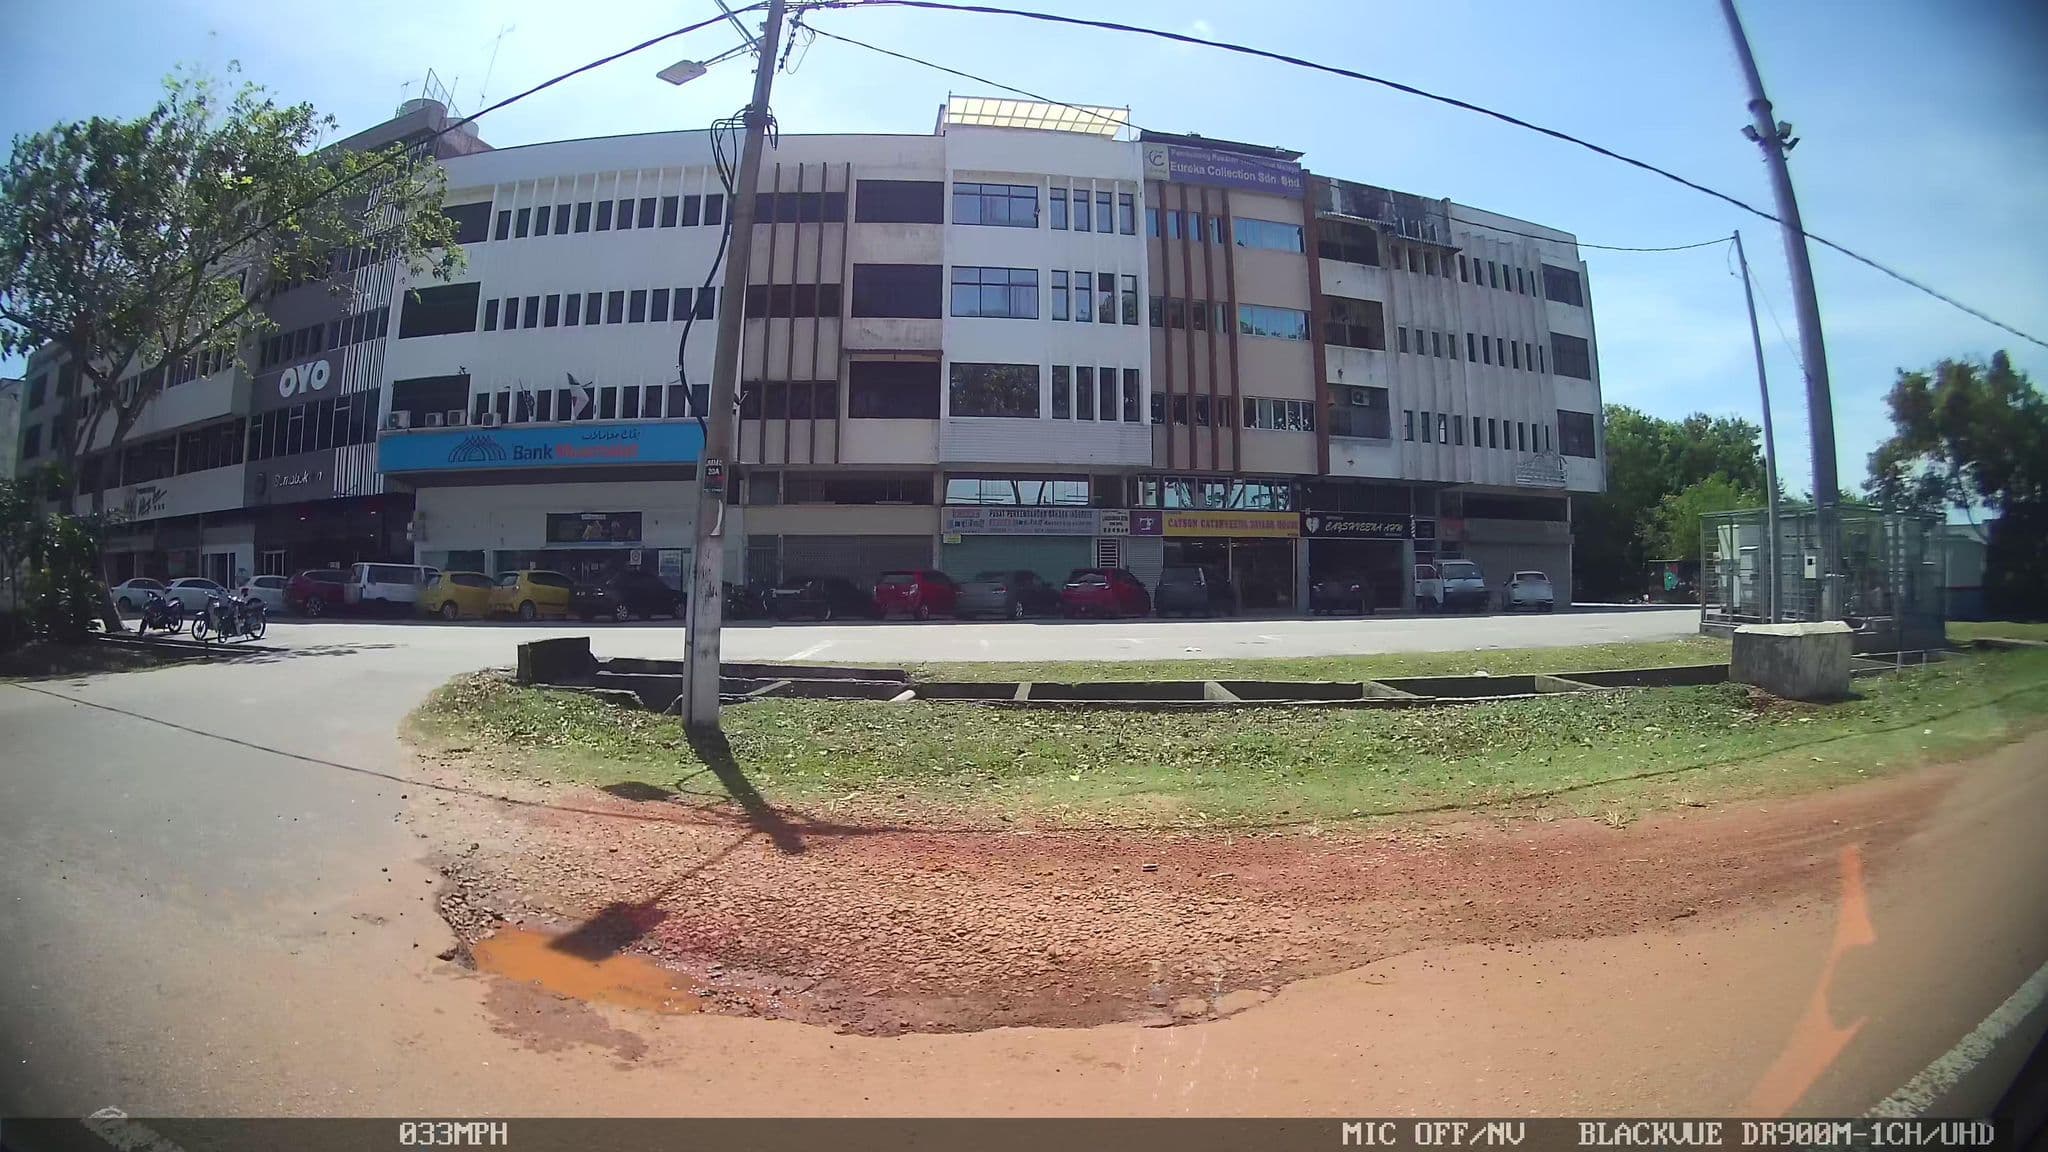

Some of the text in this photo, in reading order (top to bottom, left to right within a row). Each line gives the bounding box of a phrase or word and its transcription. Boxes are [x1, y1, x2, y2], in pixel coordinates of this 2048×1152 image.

[1170, 161, 1205, 175] Eureka
[1207, 166, 1256, 181] Collection
[279, 359, 330, 398] OYO
[513, 444, 552, 460] Bank
